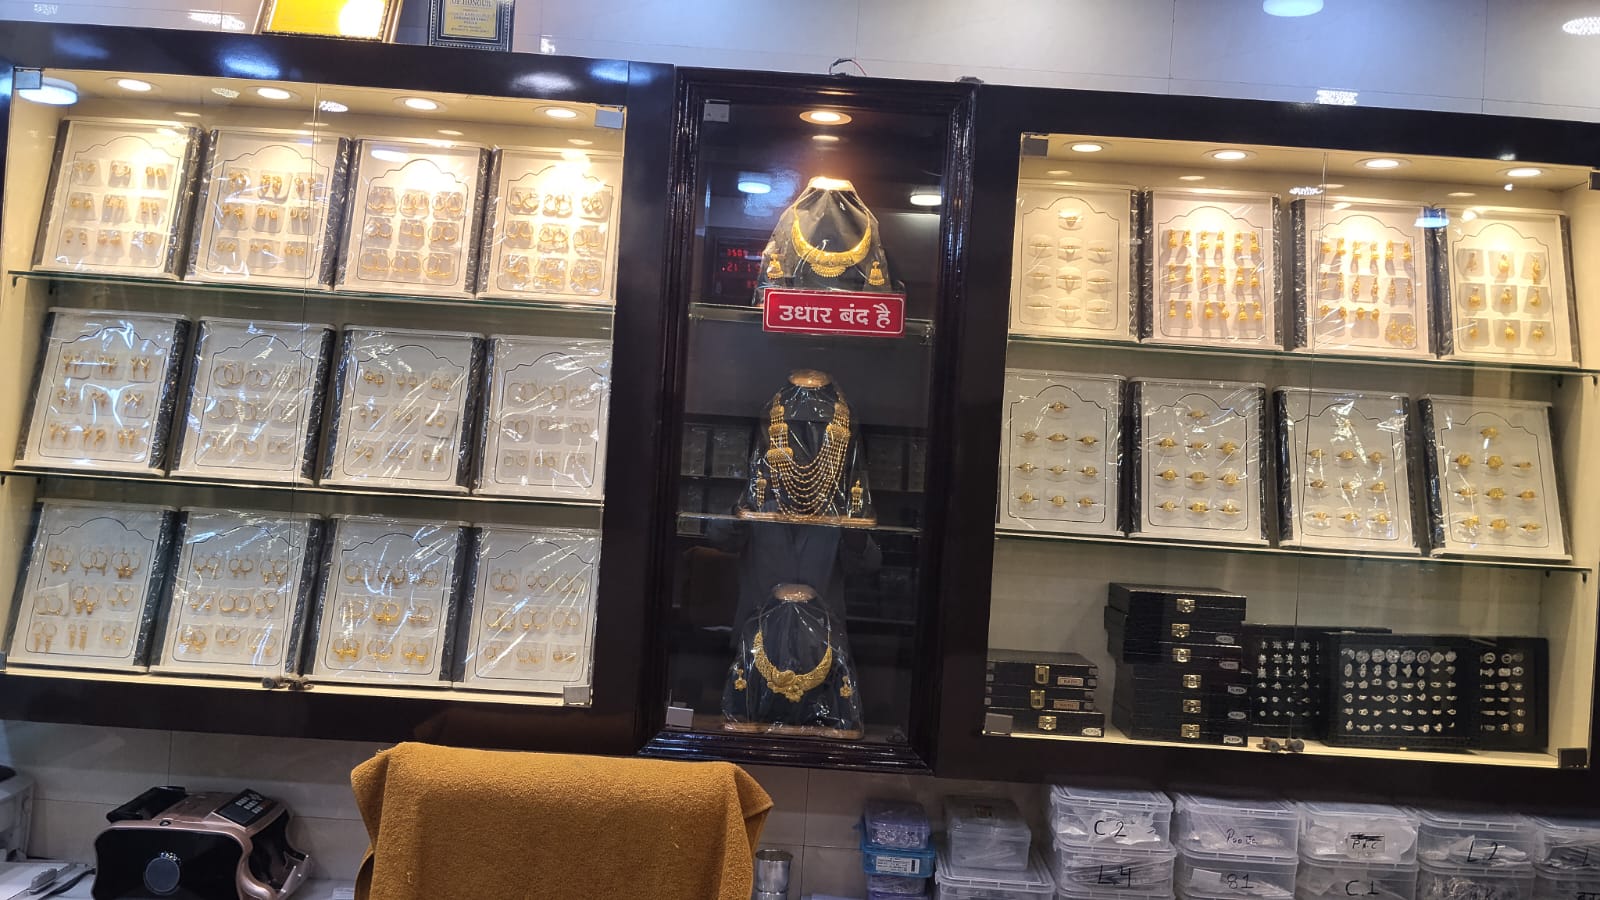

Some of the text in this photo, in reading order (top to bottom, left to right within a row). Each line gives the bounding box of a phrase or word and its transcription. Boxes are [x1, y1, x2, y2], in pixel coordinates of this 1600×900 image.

[779, 302, 891, 328] उधार बंद है
